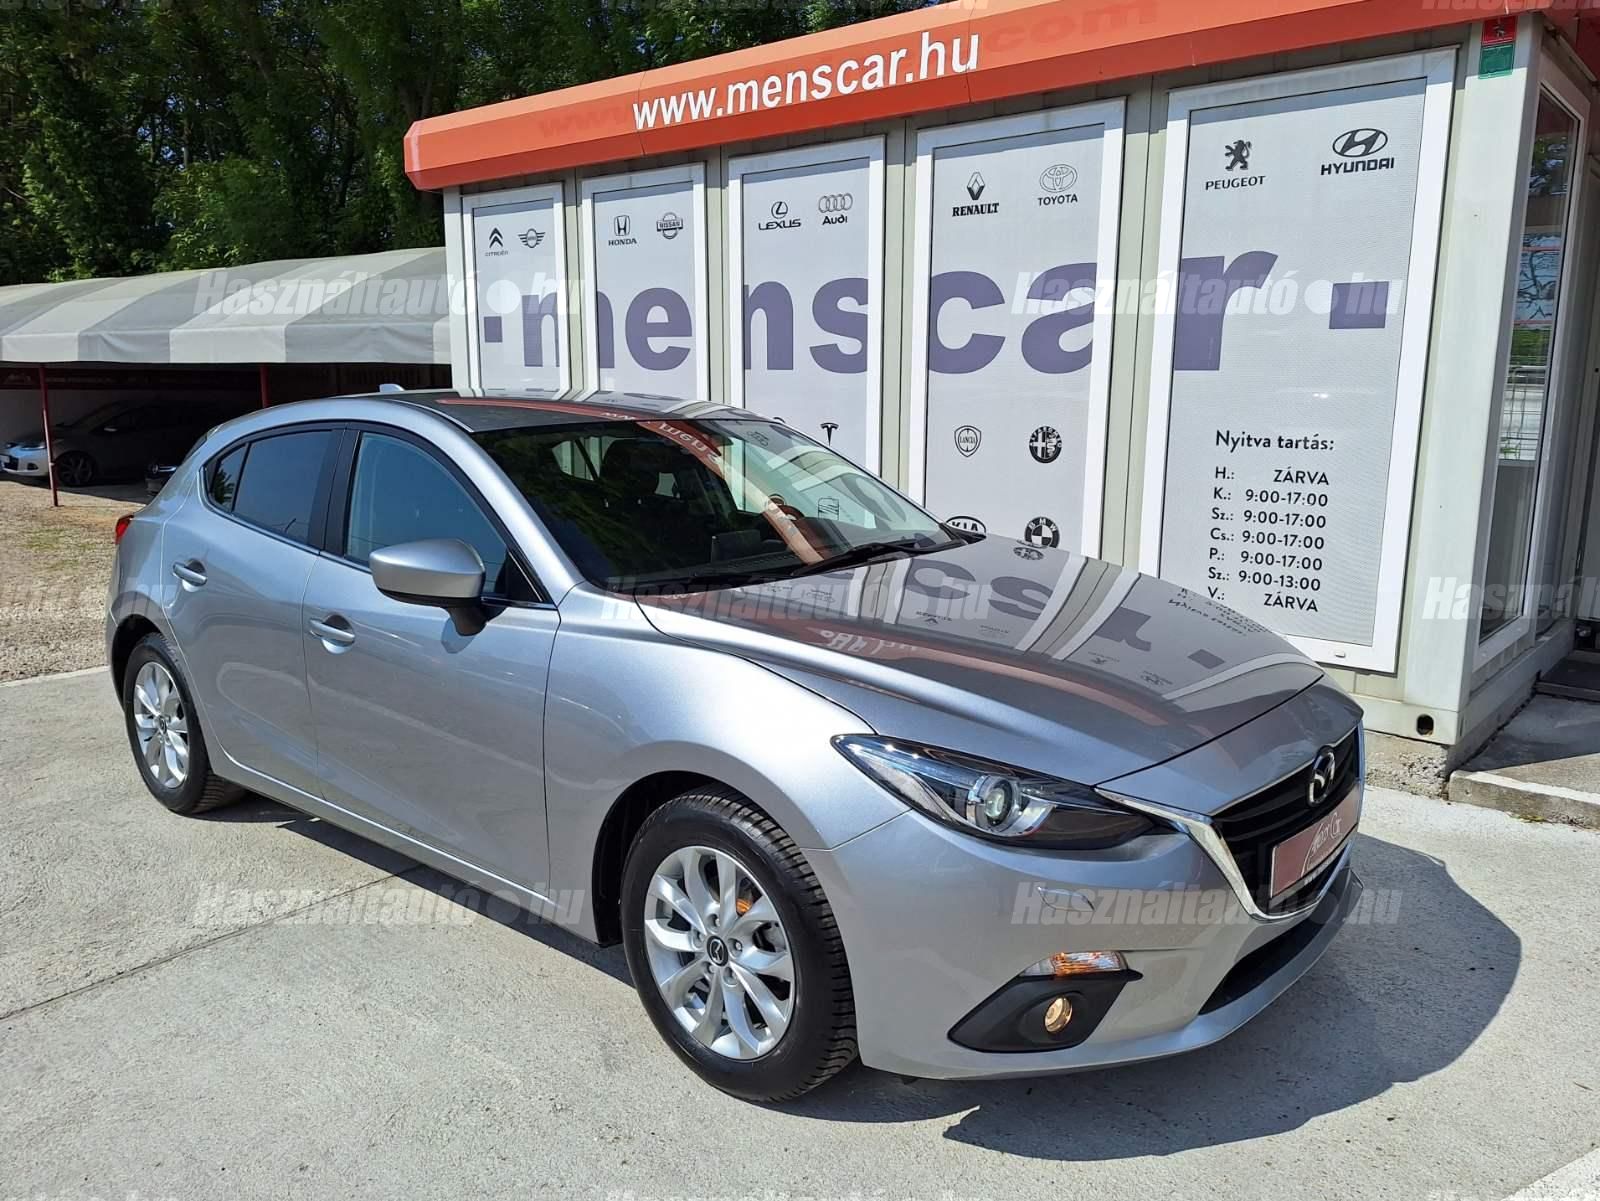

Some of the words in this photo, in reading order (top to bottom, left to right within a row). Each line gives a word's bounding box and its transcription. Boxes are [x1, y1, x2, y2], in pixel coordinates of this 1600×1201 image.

[633, 32, 980, 130] www.menscar.hu
[1320, 157, 1394, 175] HYUNDAI
[1205, 175, 1266, 190] PEUGEOT
[952, 203, 999, 217] RENAULT
[1037, 194, 1078, 206] TOYOTA
[758, 219, 802, 231] LEXUS
[822, 214, 848, 226] Audi
[608, 237, 637, 247] HONDA
[1215, 429, 1271, 453] Nyitva
[1278, 433, 1334, 450] tartás:
[1215, 466, 1235, 480] H.:
[1273, 466, 1329, 485] ZÁRVA
[1213, 486, 1231, 500] K.:
[1245, 488, 1328, 507] 9:00-17:00
[1211, 507, 1234, 520] Sz.:
[1243, 509, 1326, 528] 9:00-17:00
[1210, 527, 1234, 541] Cs.:
[1242, 530, 1324, 549] 9:00-17:00
[1209, 547, 1225, 561] P.:
[1240, 550, 1322, 571] 9:00-17:00
[1208, 566, 1230, 581] Sz.:
[1238, 570, 1321, 591] 9:00-13:00
[1207, 586, 1225, 600] V.:
[1264, 591, 1318, 612] ZÁRVA
